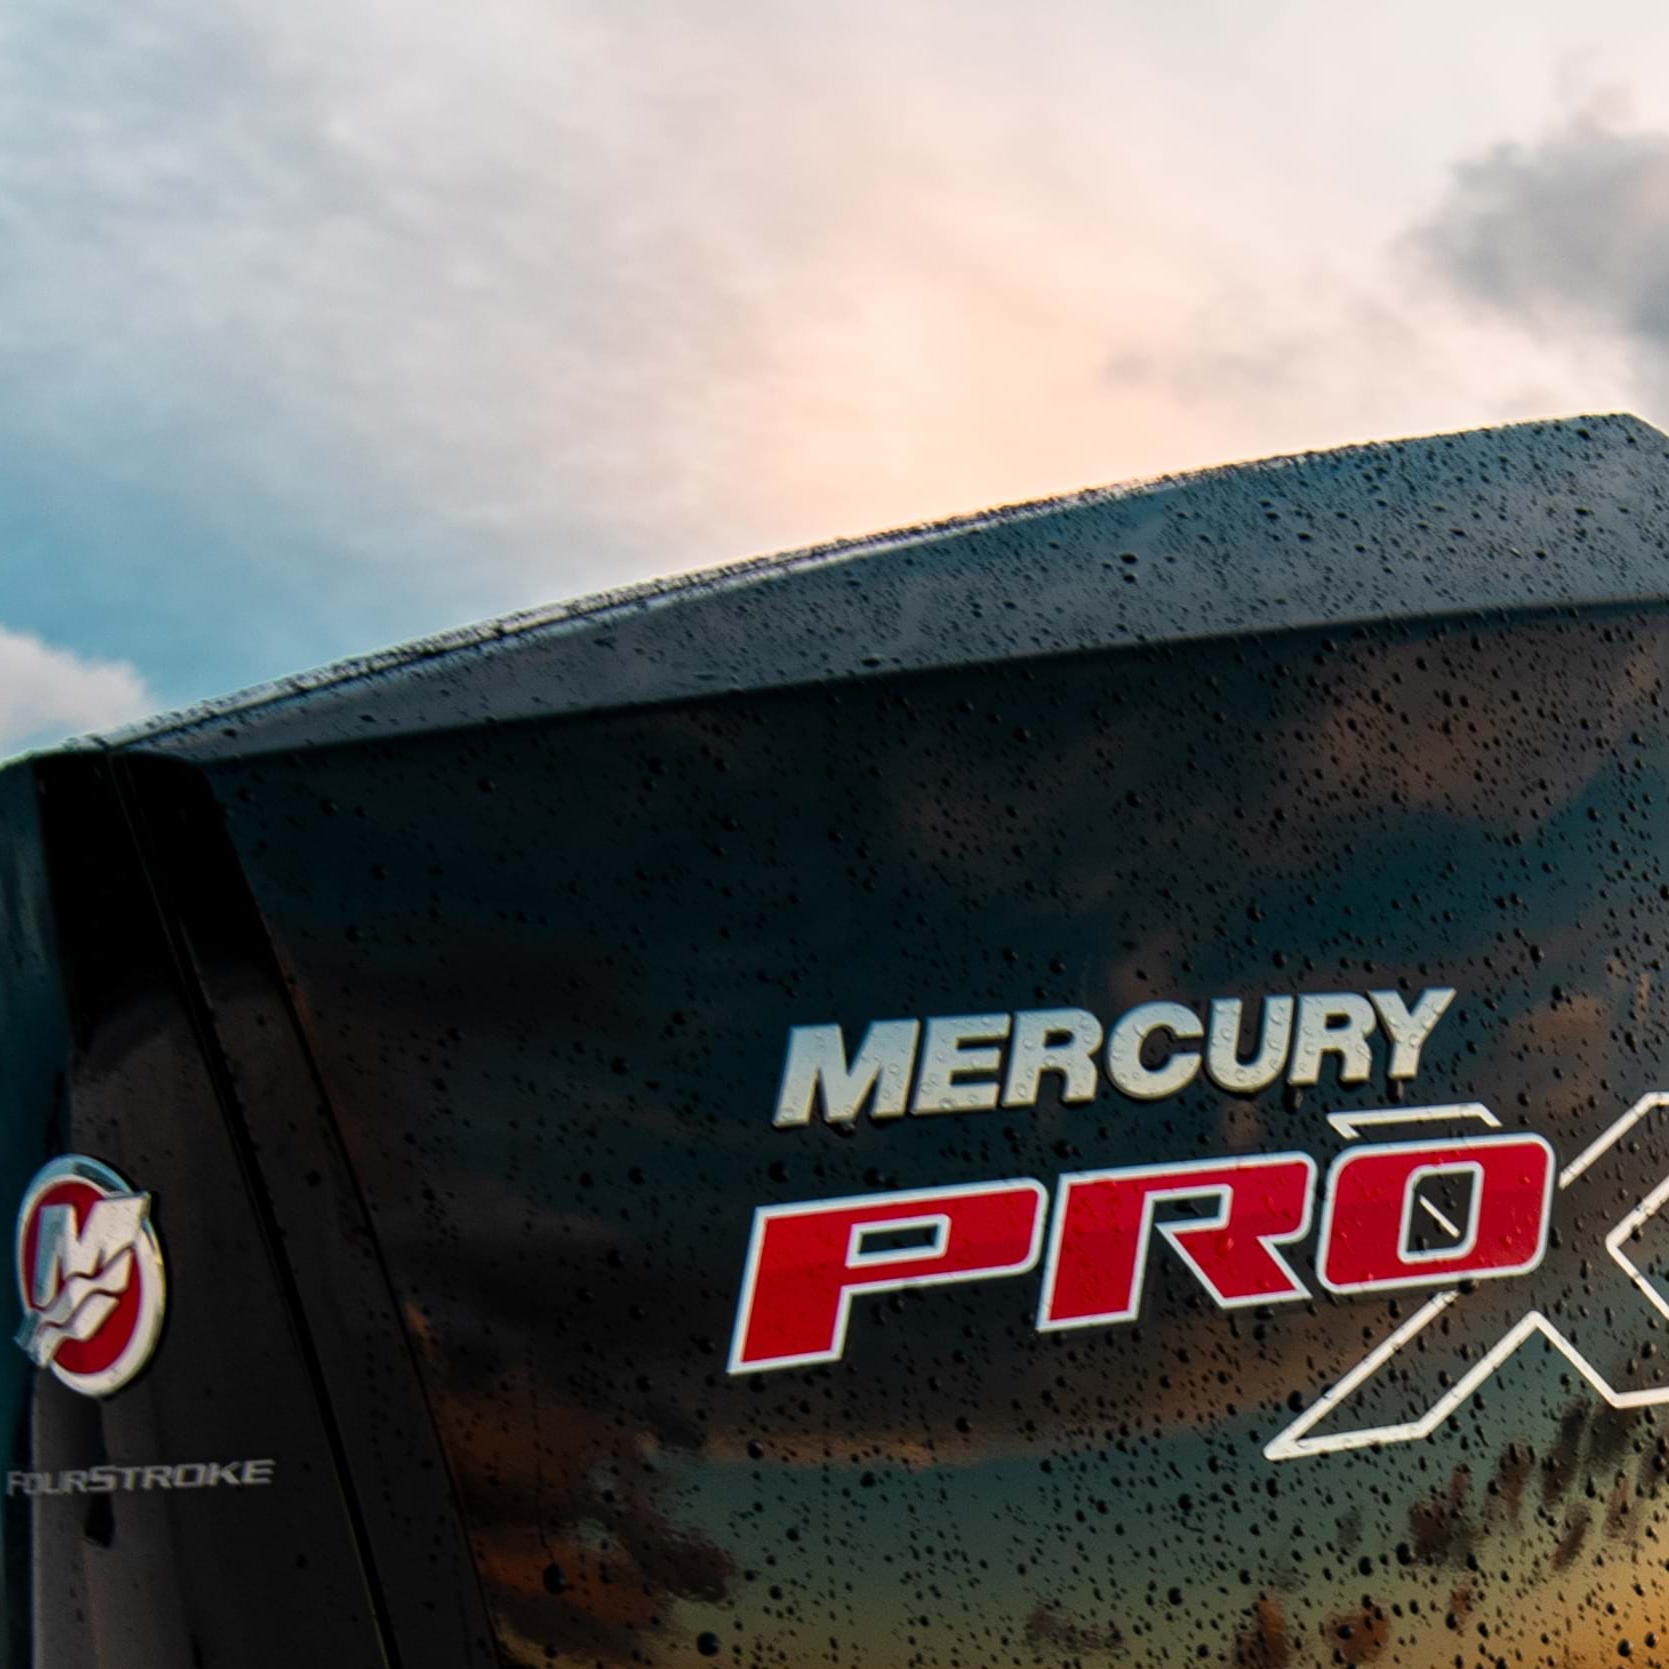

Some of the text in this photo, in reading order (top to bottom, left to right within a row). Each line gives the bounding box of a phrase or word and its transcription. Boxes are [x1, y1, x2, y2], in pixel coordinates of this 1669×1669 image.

[771, 987, 1456, 1128] MERCURY
[729, 1131, 1557, 1375] PRO
[5, 1458, 276, 1498] FOURSTROKE
